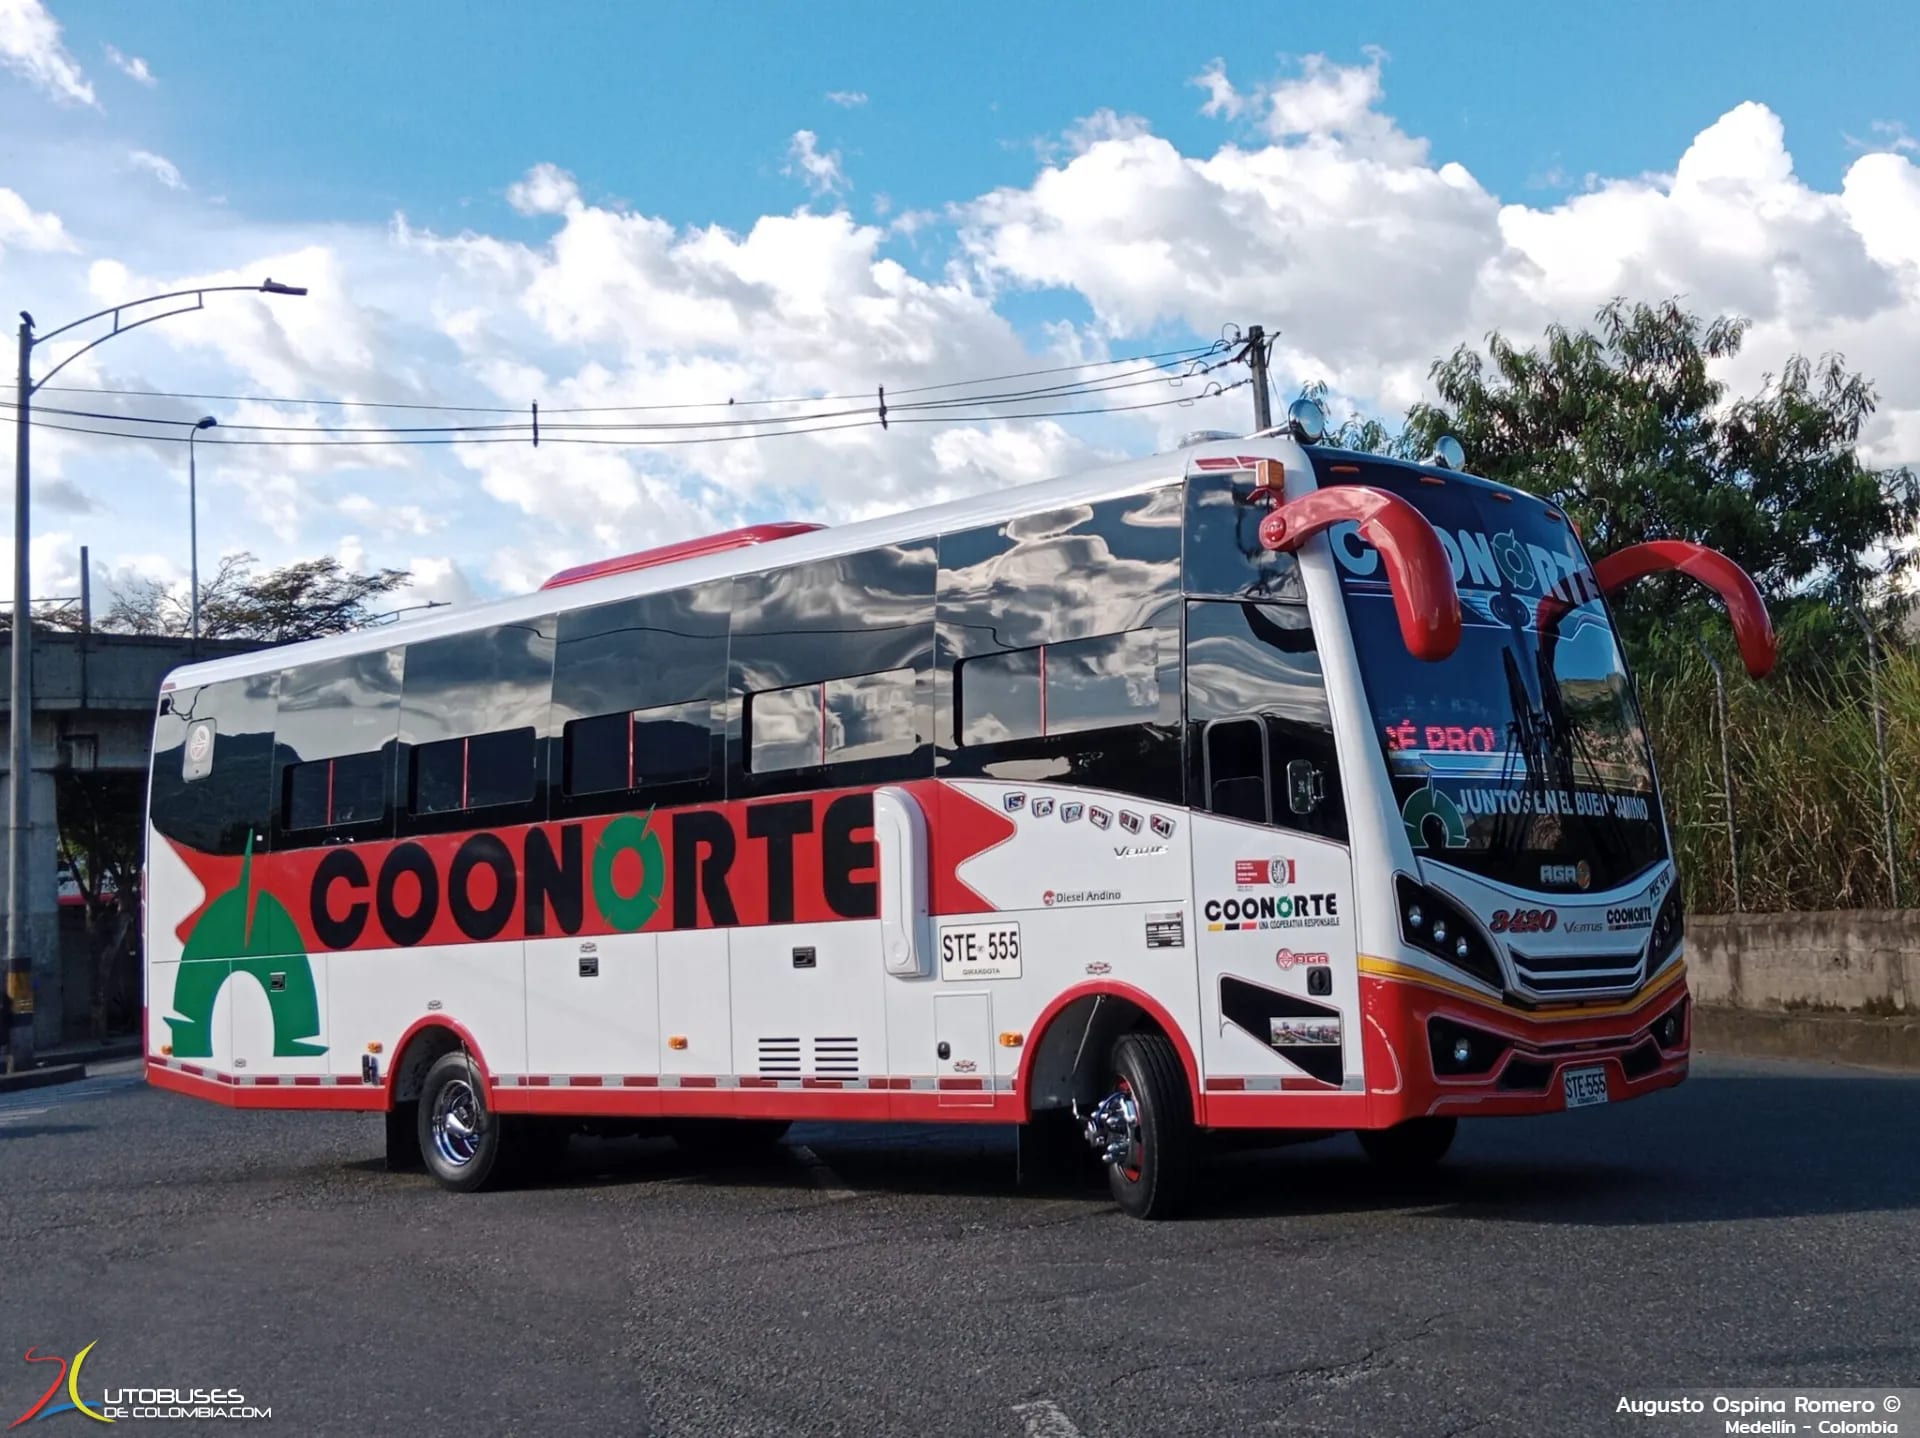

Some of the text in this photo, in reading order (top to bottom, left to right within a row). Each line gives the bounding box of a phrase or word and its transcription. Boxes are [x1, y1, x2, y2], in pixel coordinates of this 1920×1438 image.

[1534, 790, 1559, 815] EN
[1559, 790, 1574, 815] EL
[310, 792, 879, 950] COONORTE
[1056, 889, 1121, 902] Diesel Andino
[1204, 893, 1338, 922] COONORTE
[943, 931, 1019, 962] STE 555
[1565, 1073, 1606, 1098] STE 555
